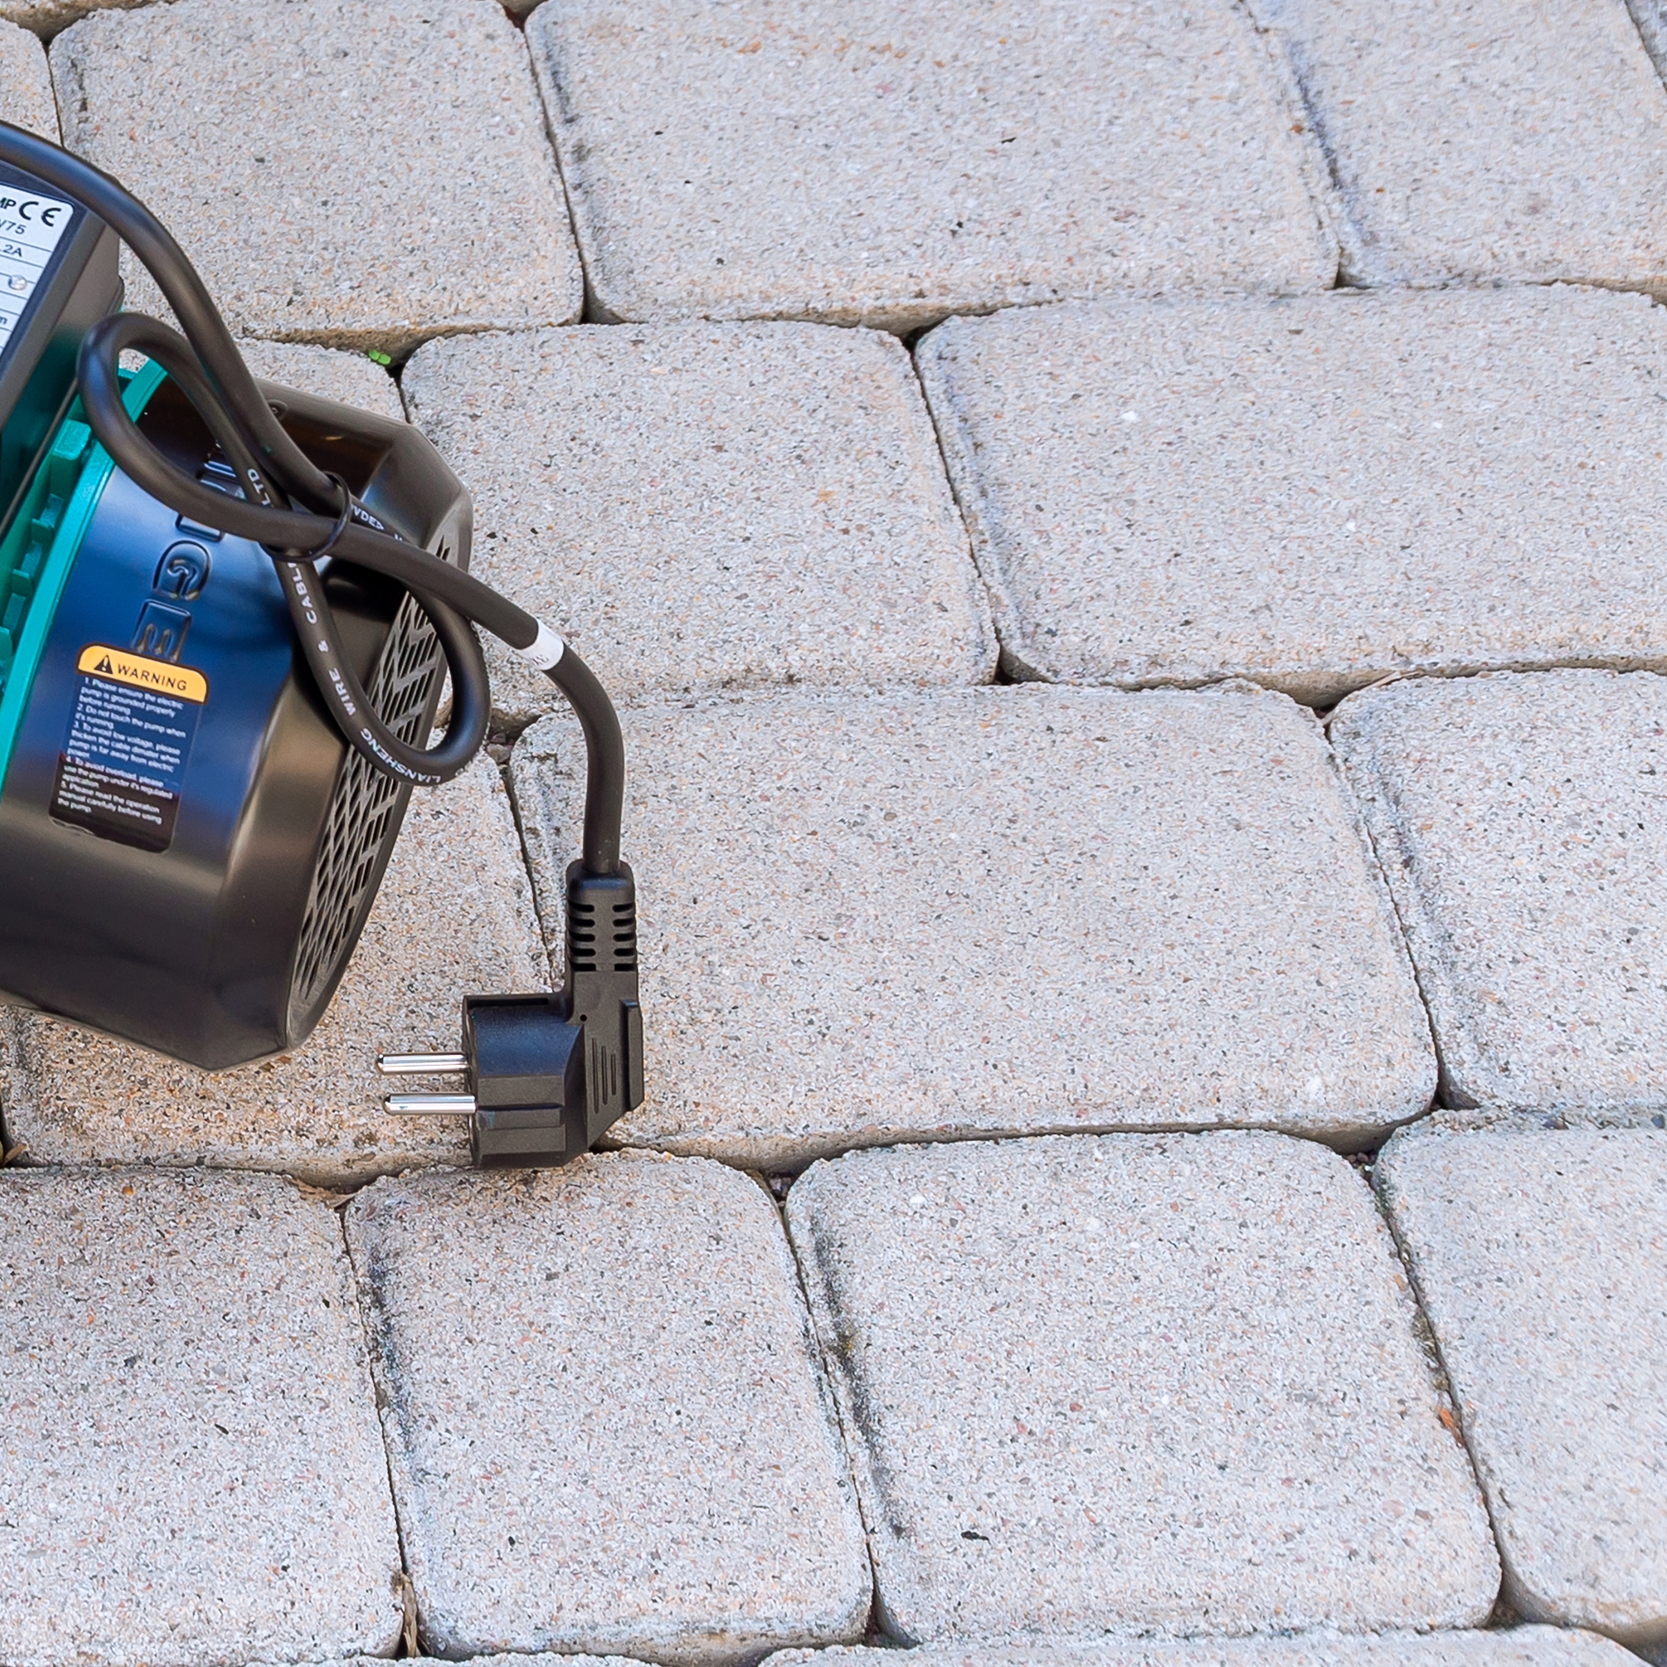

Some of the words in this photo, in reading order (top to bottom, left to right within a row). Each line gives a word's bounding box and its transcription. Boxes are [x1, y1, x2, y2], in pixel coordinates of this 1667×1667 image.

[117, 662, 187, 691] WARNING
[328, 667, 357, 716] WIRE
[360, 727, 441, 783] LIANSHENG
